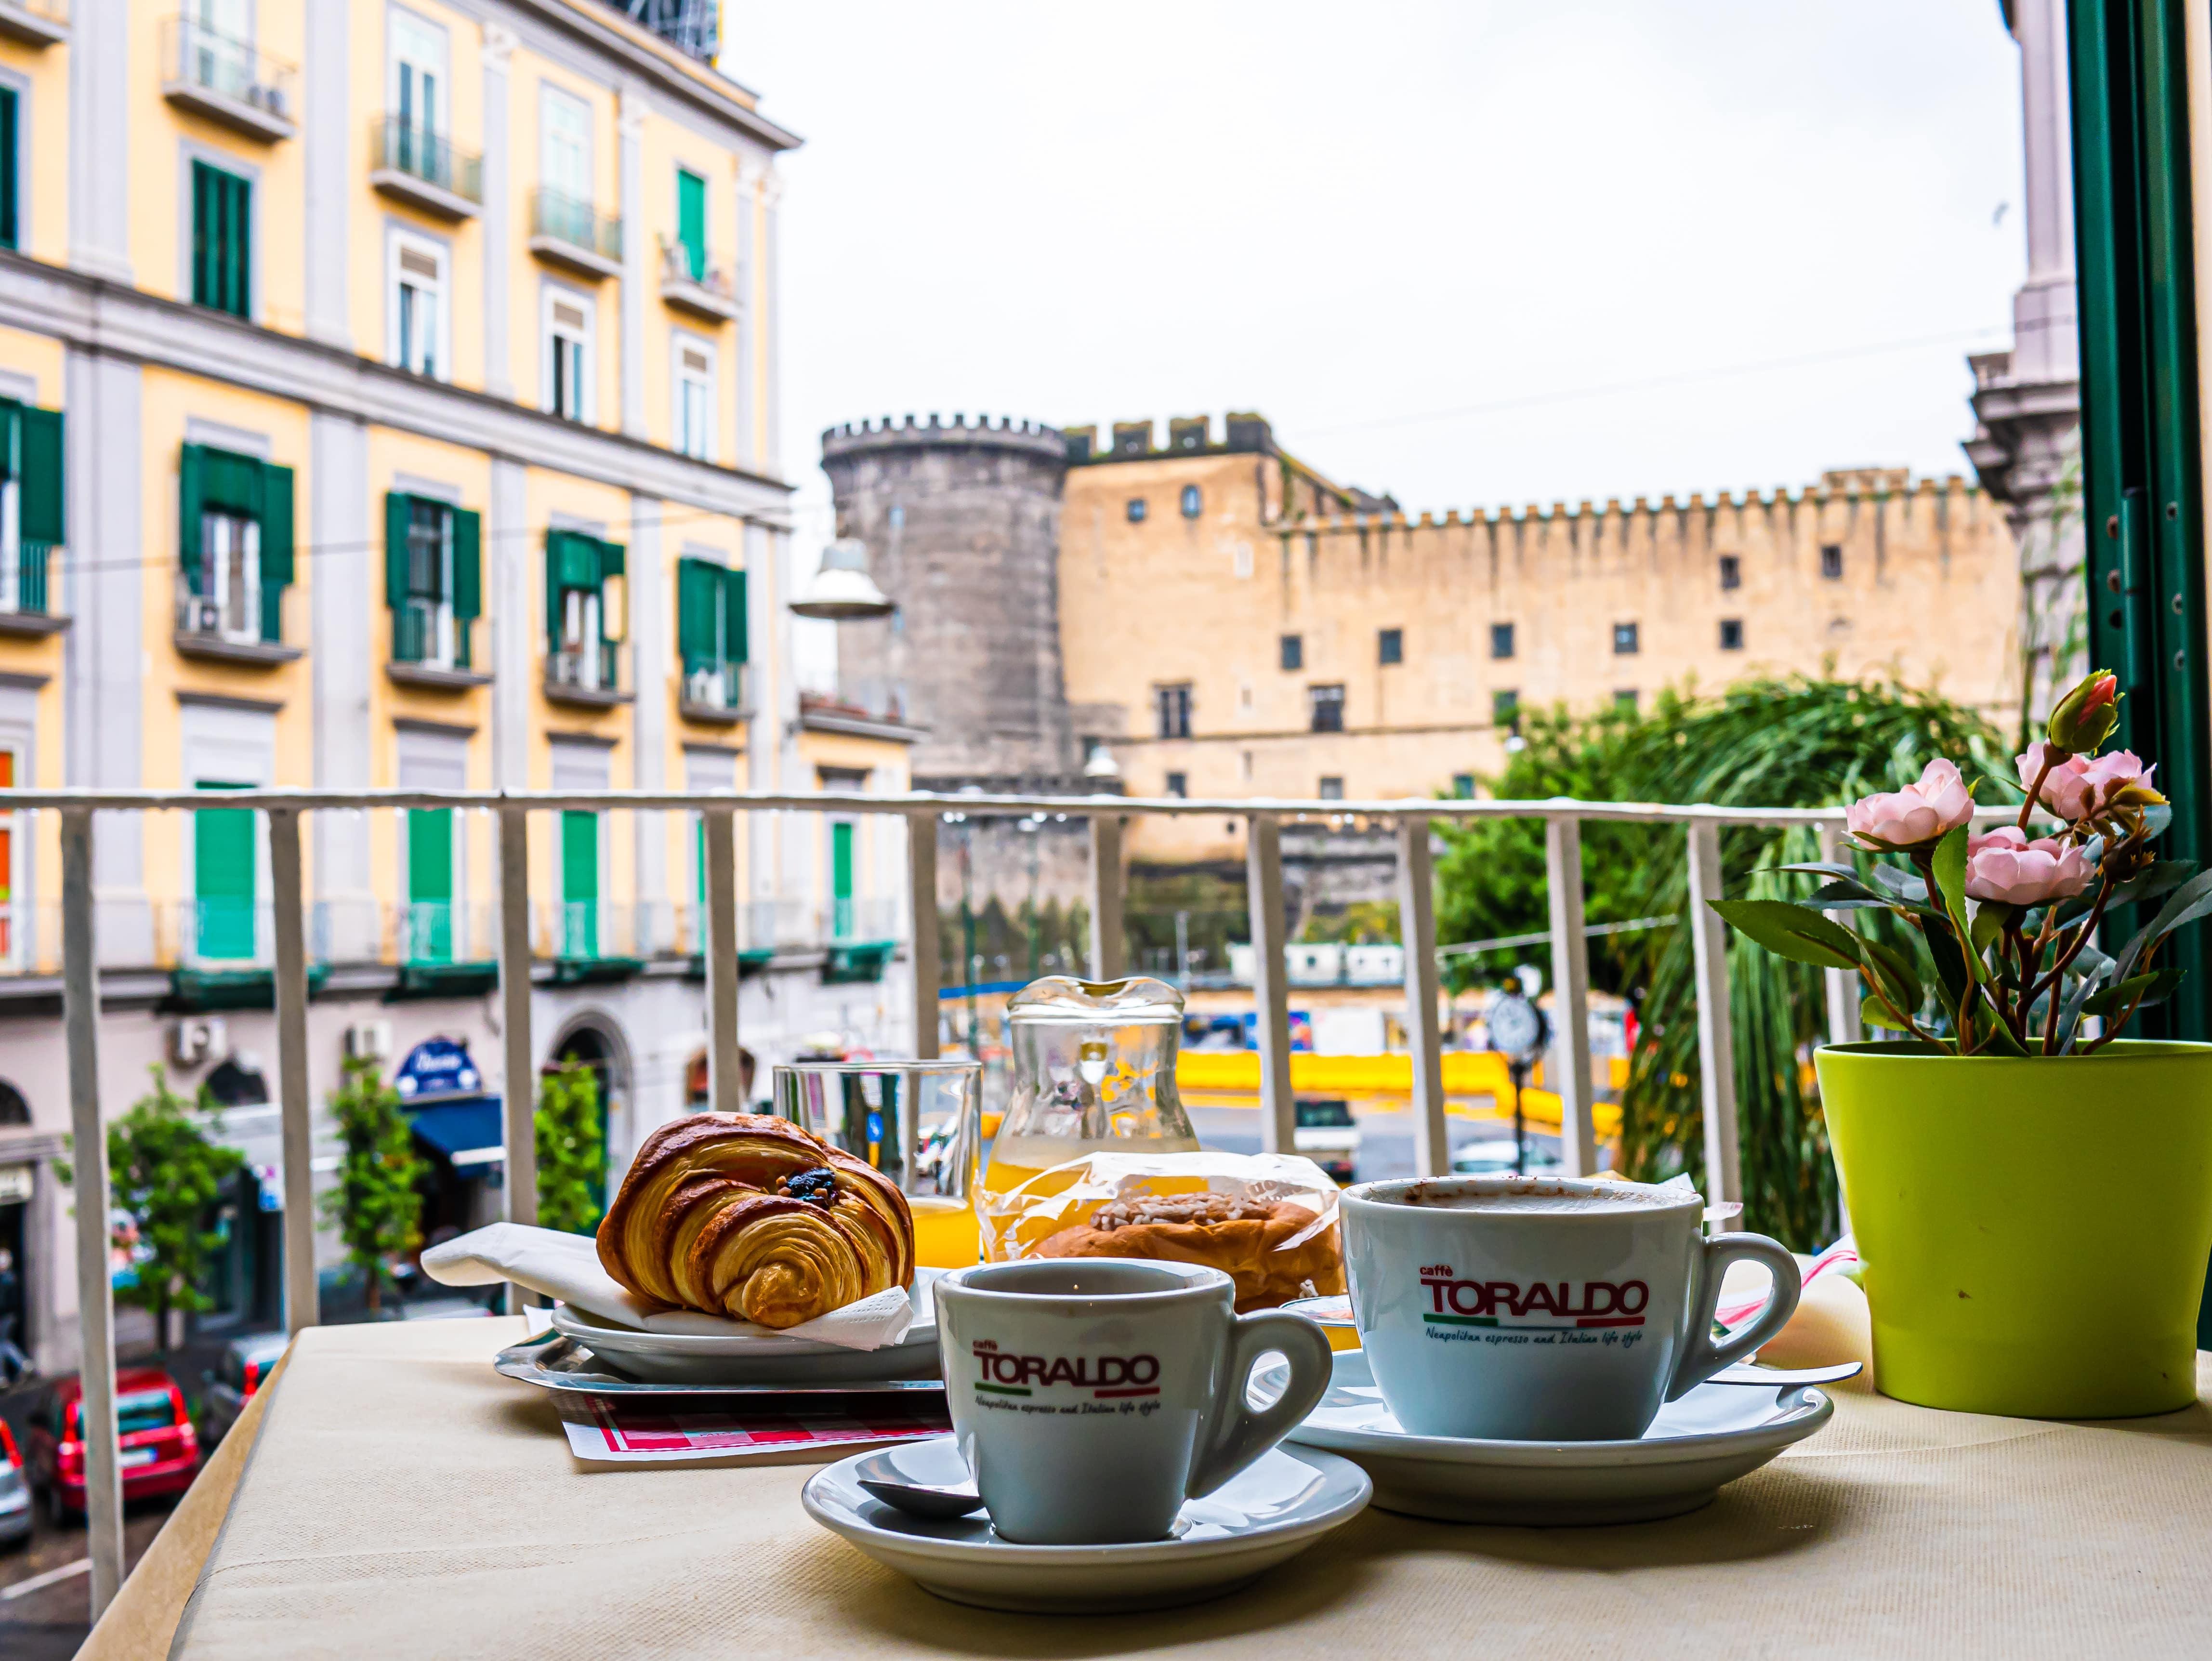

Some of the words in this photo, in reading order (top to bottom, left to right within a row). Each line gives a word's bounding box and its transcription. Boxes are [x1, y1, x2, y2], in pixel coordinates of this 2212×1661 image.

[1420, 1264, 1453, 1277] caffè
[1420, 1278, 1649, 1317] TORALDO
[1425, 1325, 1480, 1343] Neapolitan
[1485, 1333, 1529, 1345] espresso
[1533, 1333, 1555, 1344] and
[1559, 1331, 1598, 1344] Italian
[1602, 1330, 1619, 1346] life
[1621, 1330, 1644, 1348] style
[973, 1350, 1160, 1387] TORALDO
